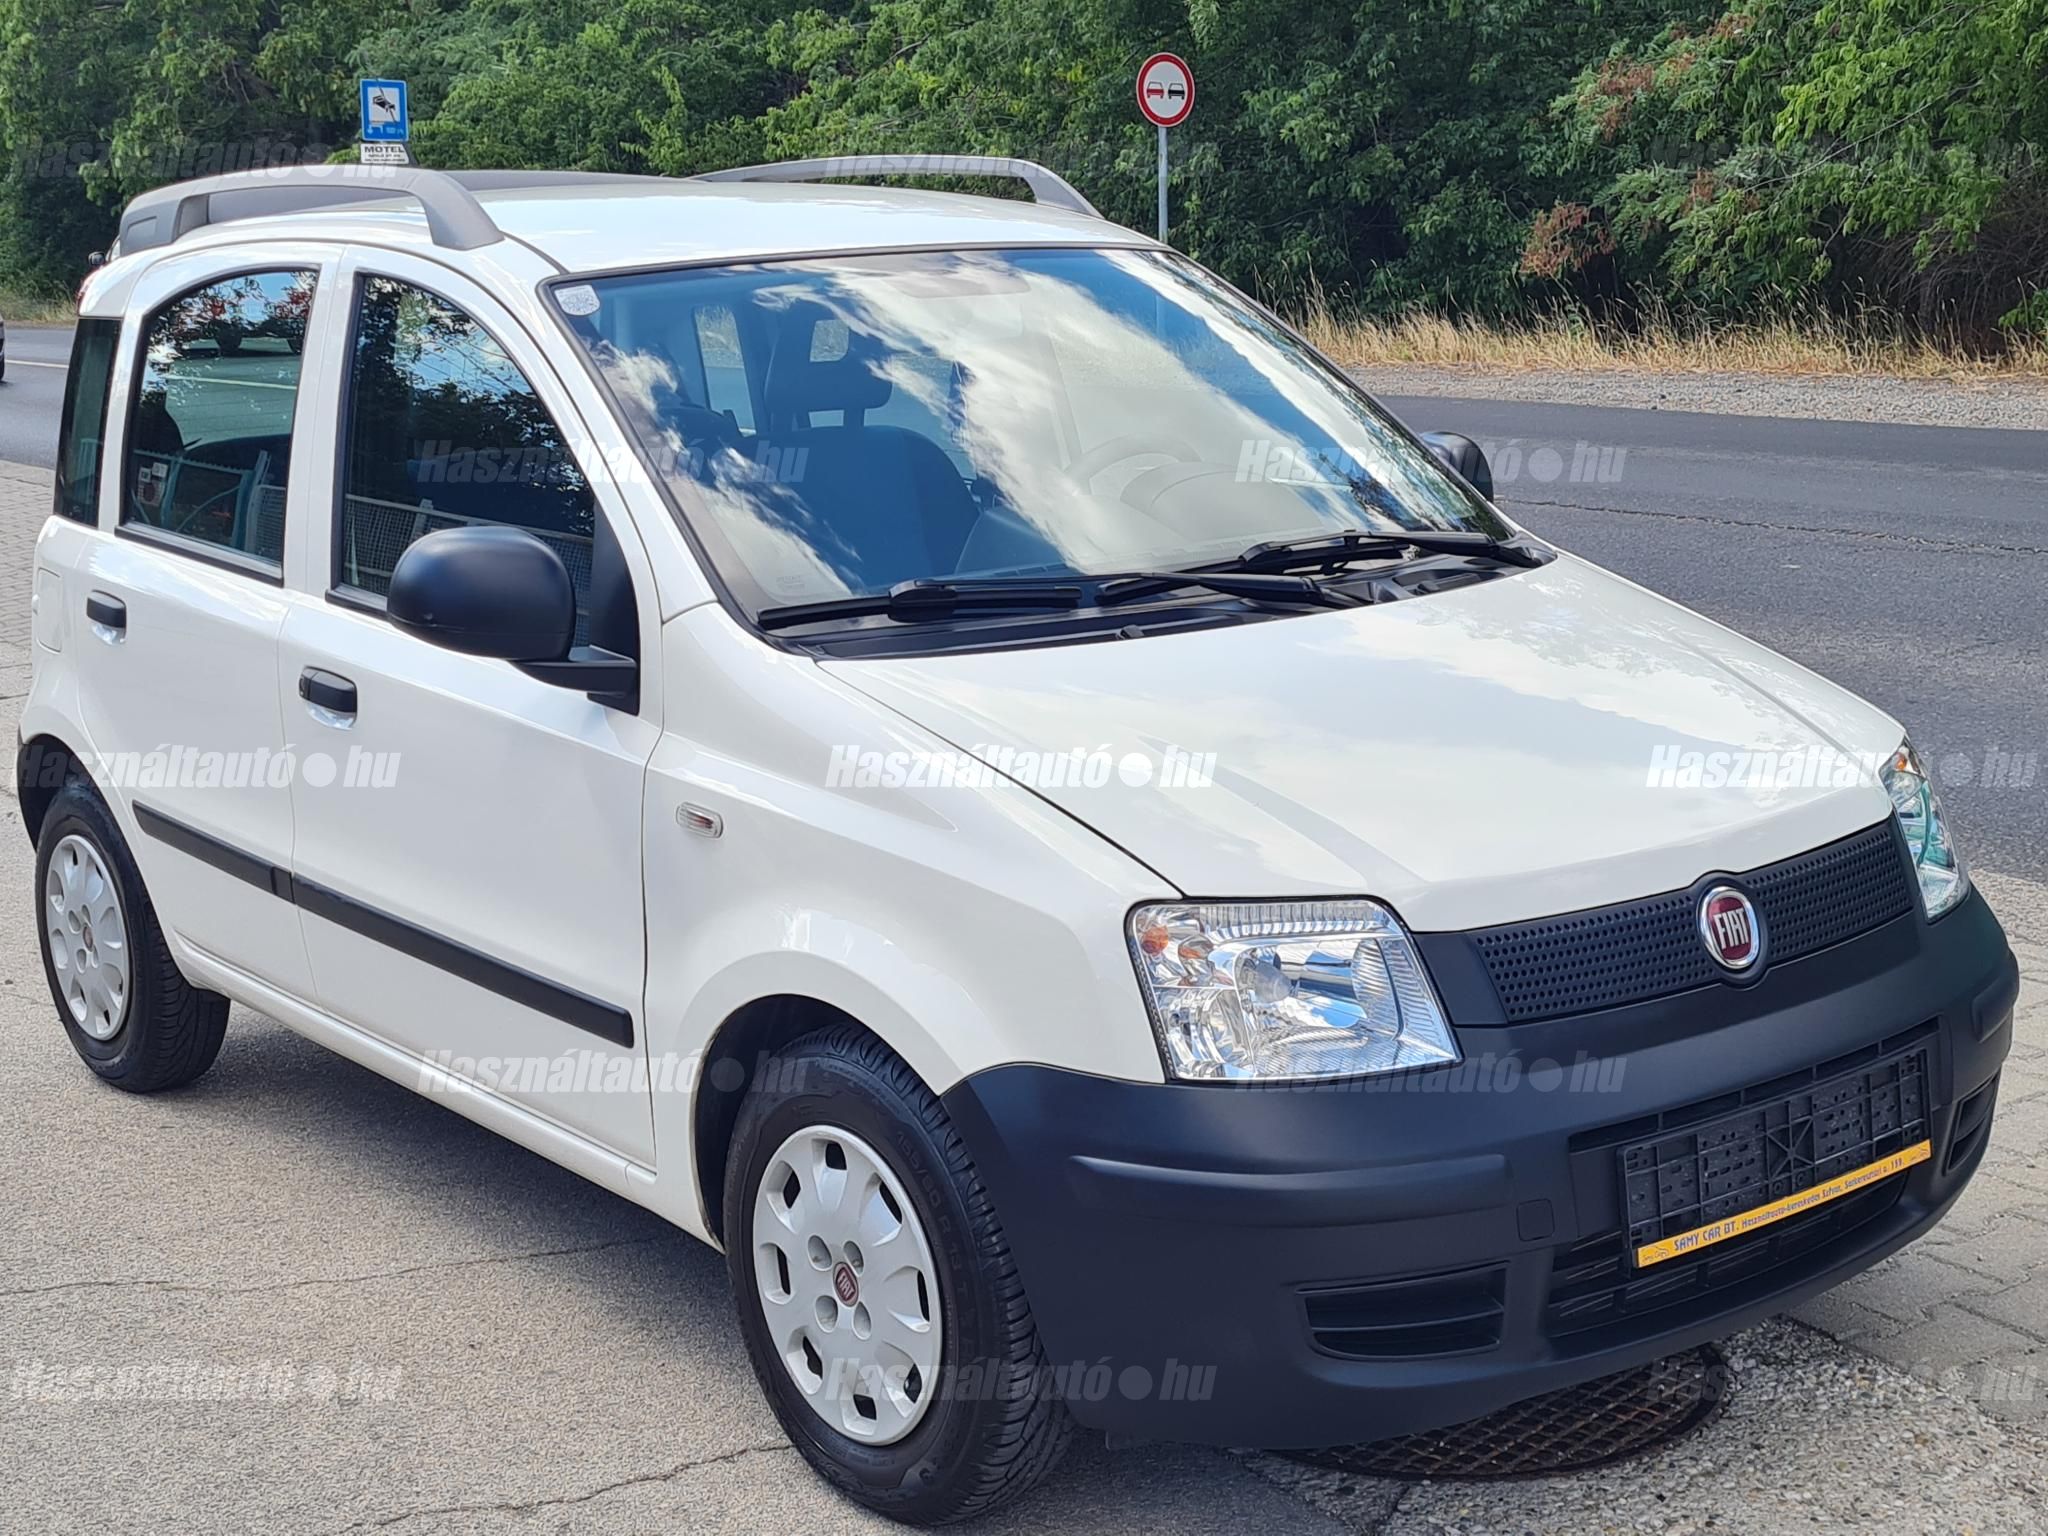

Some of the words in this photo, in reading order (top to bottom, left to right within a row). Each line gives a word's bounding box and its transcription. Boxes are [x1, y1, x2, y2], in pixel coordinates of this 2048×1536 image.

[1713, 908, 1749, 950] FIAT
[1674, 1233, 1699, 1251] SAMY
[1702, 1226, 1721, 1241] CAR
[838, 1271, 854, 1298] FIAT
